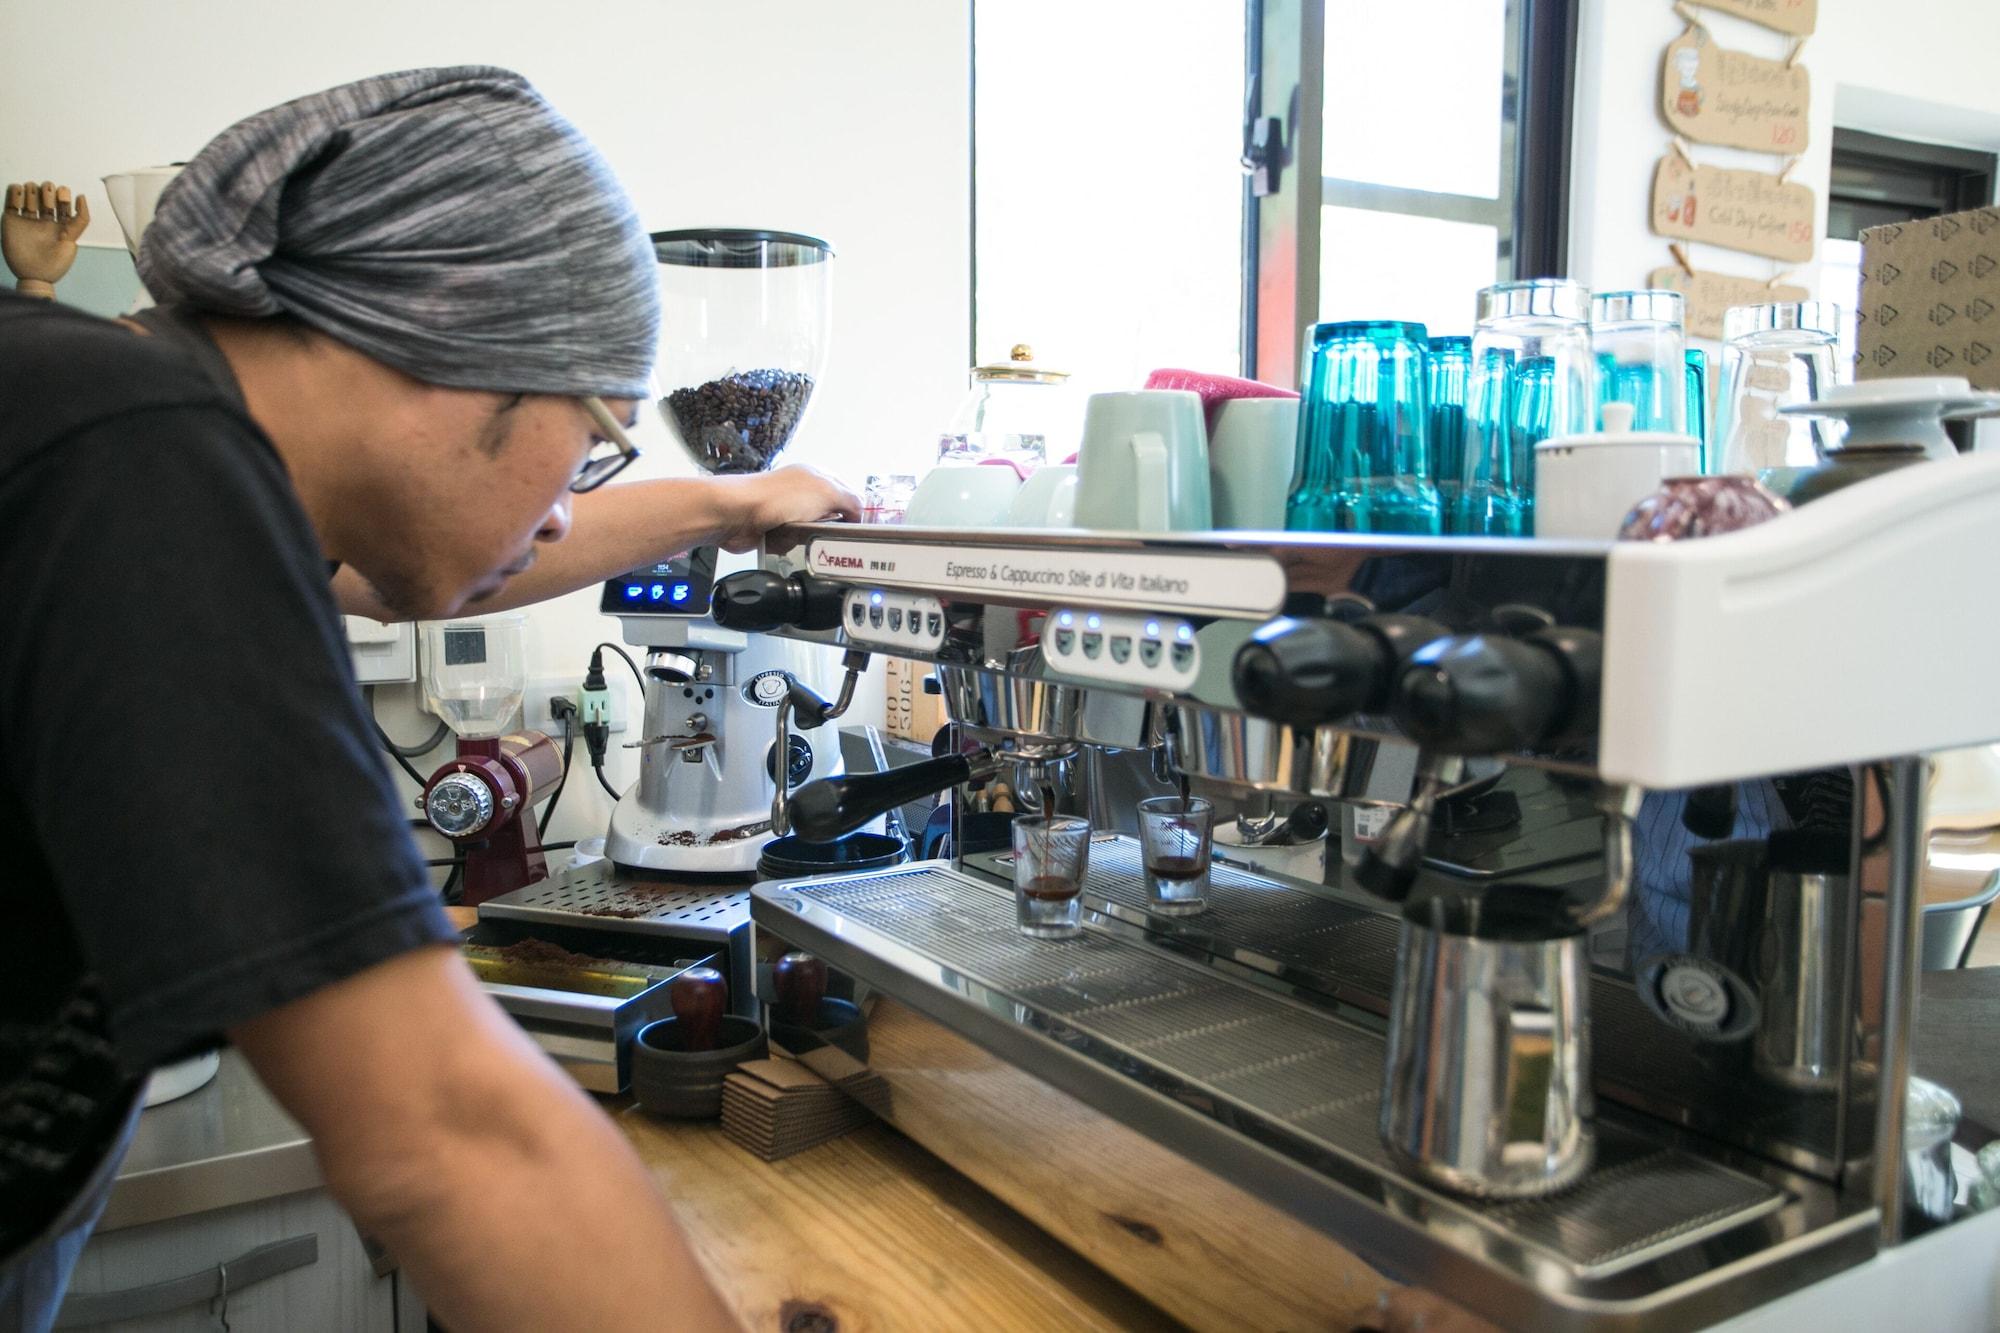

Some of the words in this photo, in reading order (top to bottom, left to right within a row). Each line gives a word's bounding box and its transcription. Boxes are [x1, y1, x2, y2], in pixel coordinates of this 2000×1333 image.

[828, 555, 864, 569] FAEMA
[946, 561, 988, 581] Espresso
[990, 564, 998, 580] &
[1001, 565, 1065, 586] Cappuccino
[1068, 569, 1092, 588] Stile
[1095, 571, 1108, 589] di
[1111, 571, 1135, 591] Vita
[1138, 573, 1189, 595] Italiano
